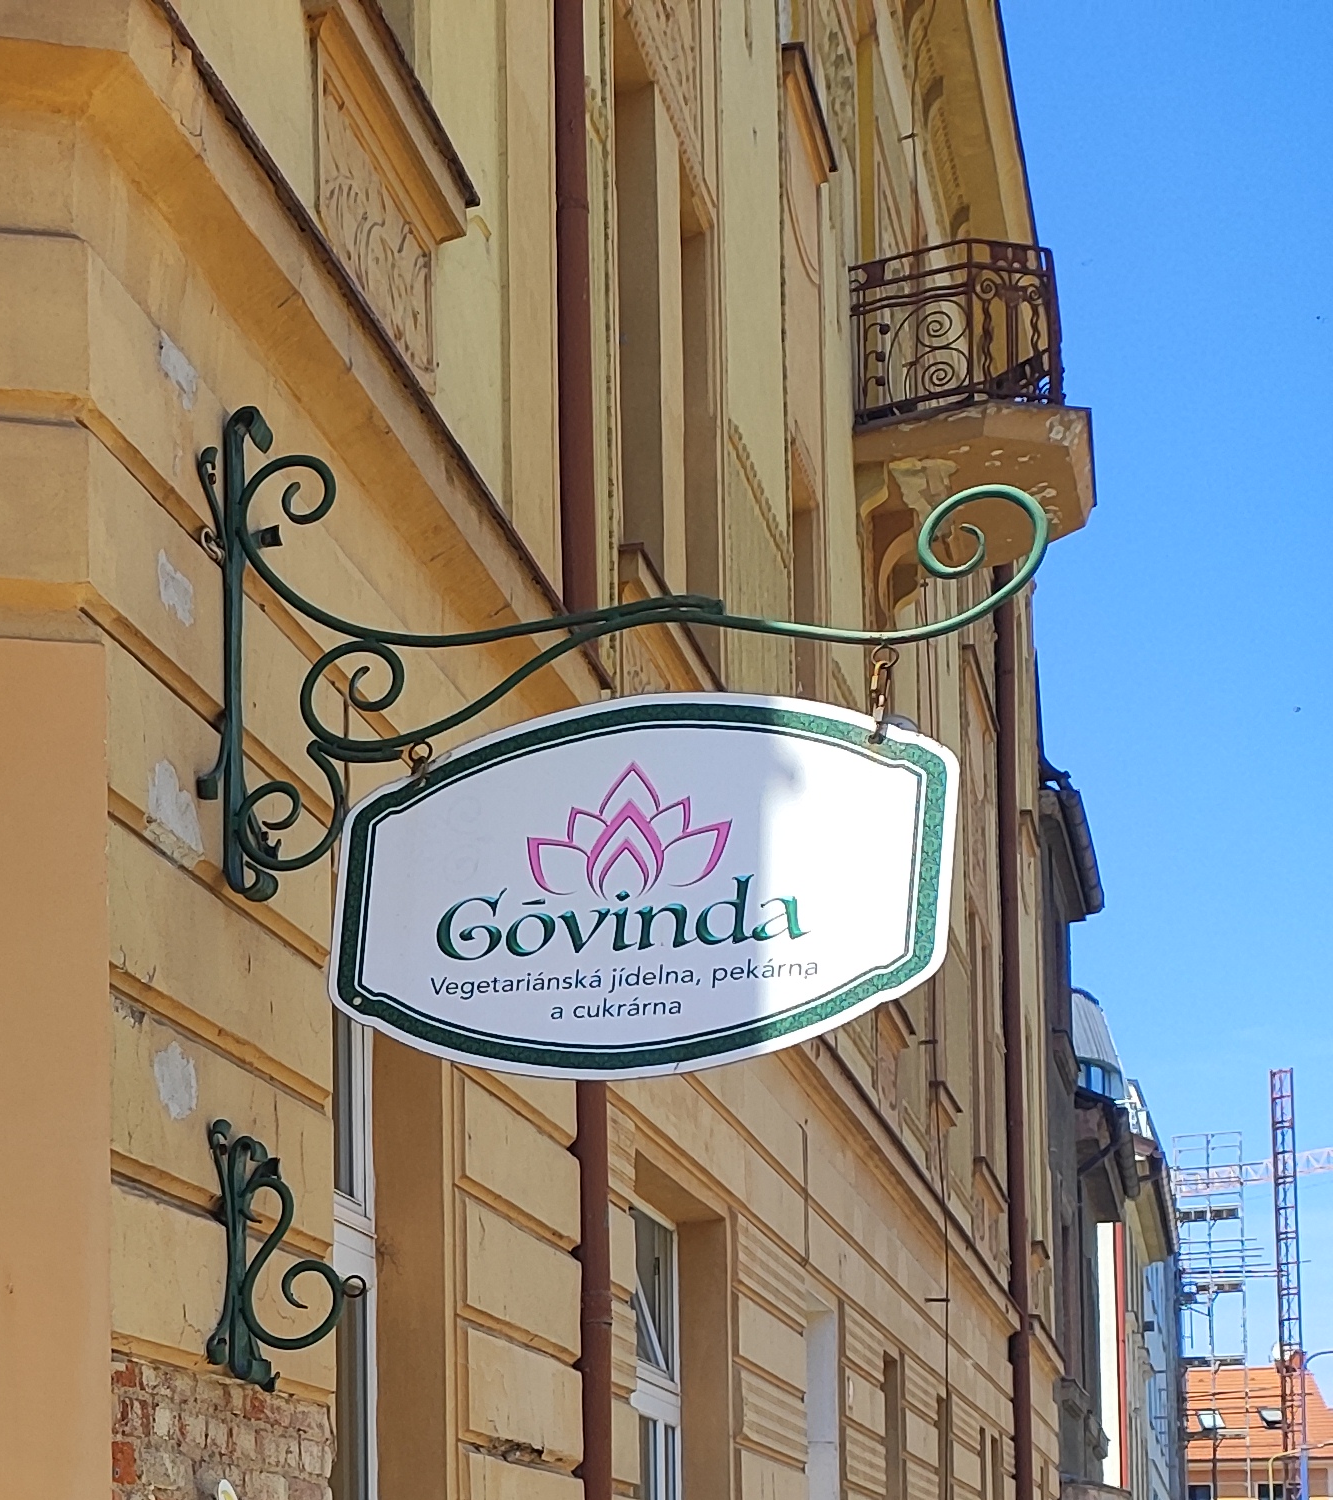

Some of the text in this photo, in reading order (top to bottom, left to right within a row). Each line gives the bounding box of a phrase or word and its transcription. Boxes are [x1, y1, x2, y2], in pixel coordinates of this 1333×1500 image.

[435, 874, 811, 962] Gōvinda
[430, 959, 819, 1001] Vegetariánská jídelna, pekárna
[550, 996, 682, 1020] a cukrárna
